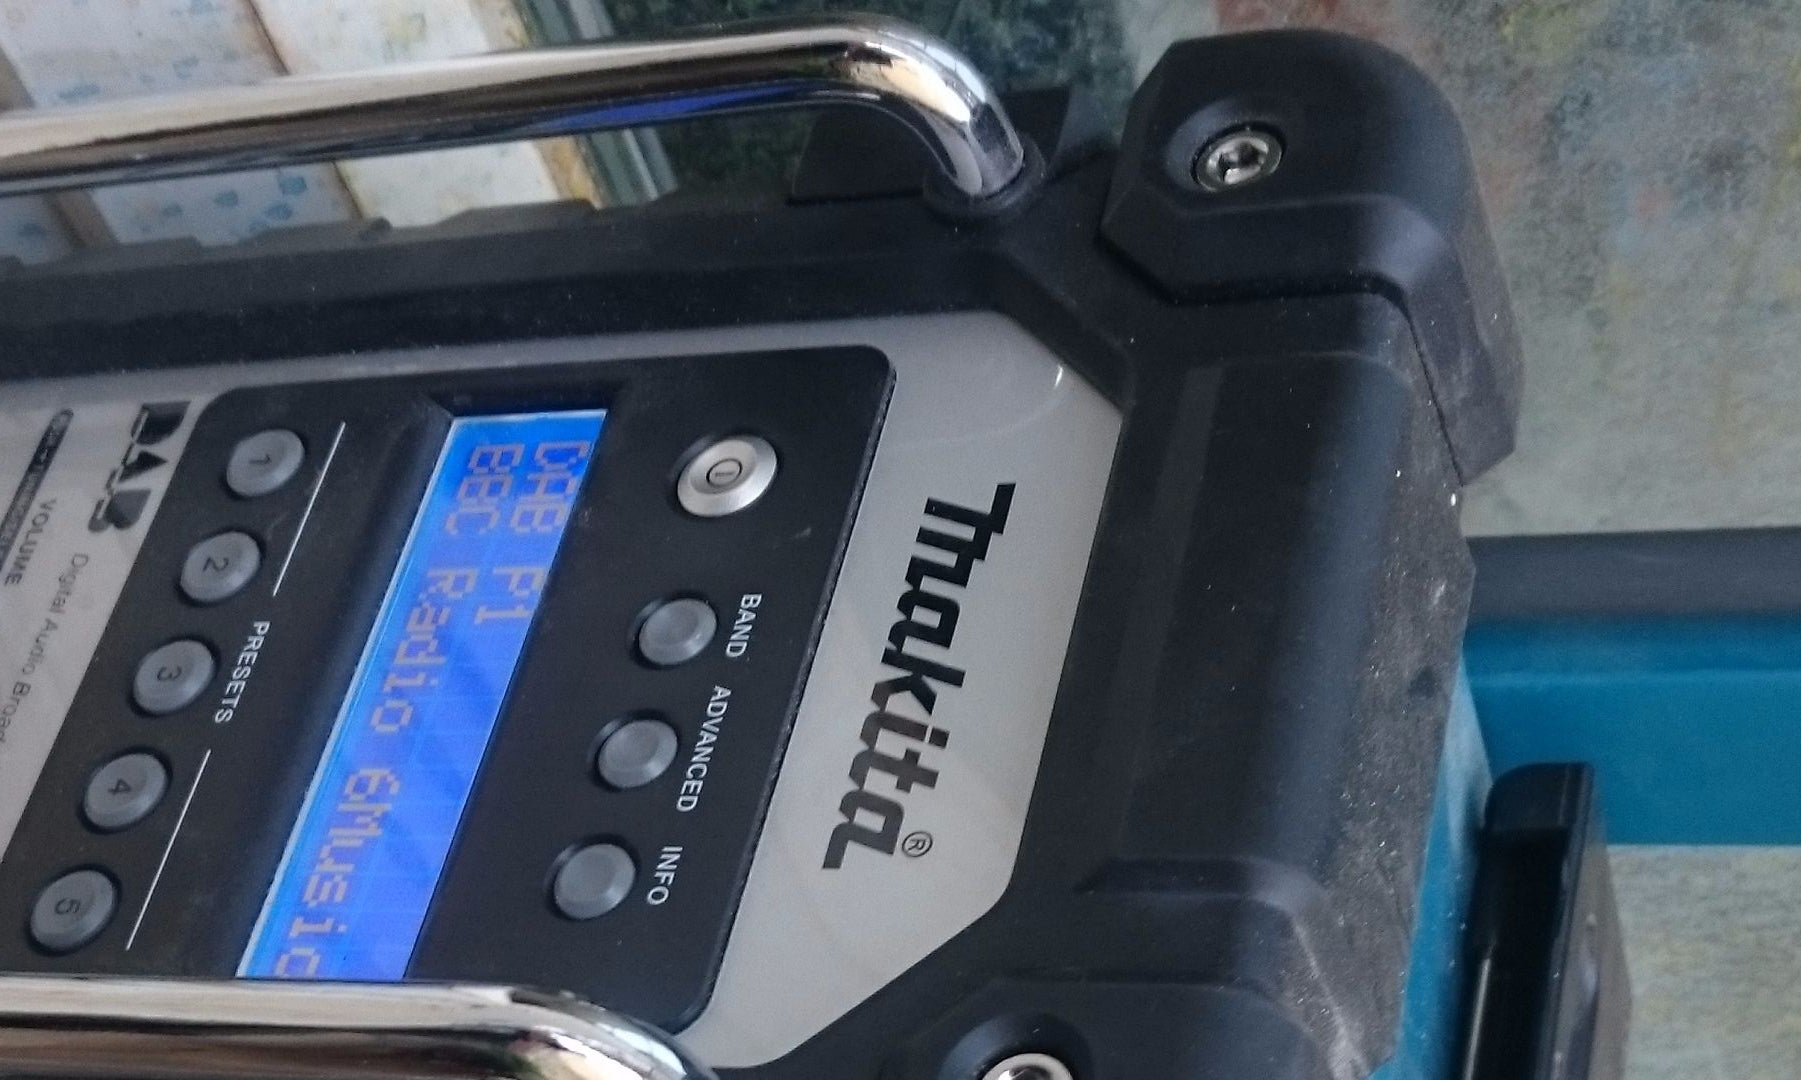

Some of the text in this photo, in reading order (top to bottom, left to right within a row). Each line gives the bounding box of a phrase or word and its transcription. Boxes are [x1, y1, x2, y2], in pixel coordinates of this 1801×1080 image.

[248, 453, 271, 465] 1
[444, 442, 526, 536] BBC
[4, 498, 58, 586] VOLUME
[474, 440, 591, 625] DAB P1
[49, 552, 89, 616] Digital
[203, 557, 229, 573] 2
[22, 616, 59, 676] Audio
[369, 568, 479, 734] Radio
[725, 592, 763, 659] BAND
[156, 666, 181, 682] 3
[214, 620, 271, 723] PRESETS
[675, 684, 732, 813] ADVANCED
[108, 778, 132, 796] 4
[55, 898, 79, 915] 5
[646, 844, 684, 906] INFO
